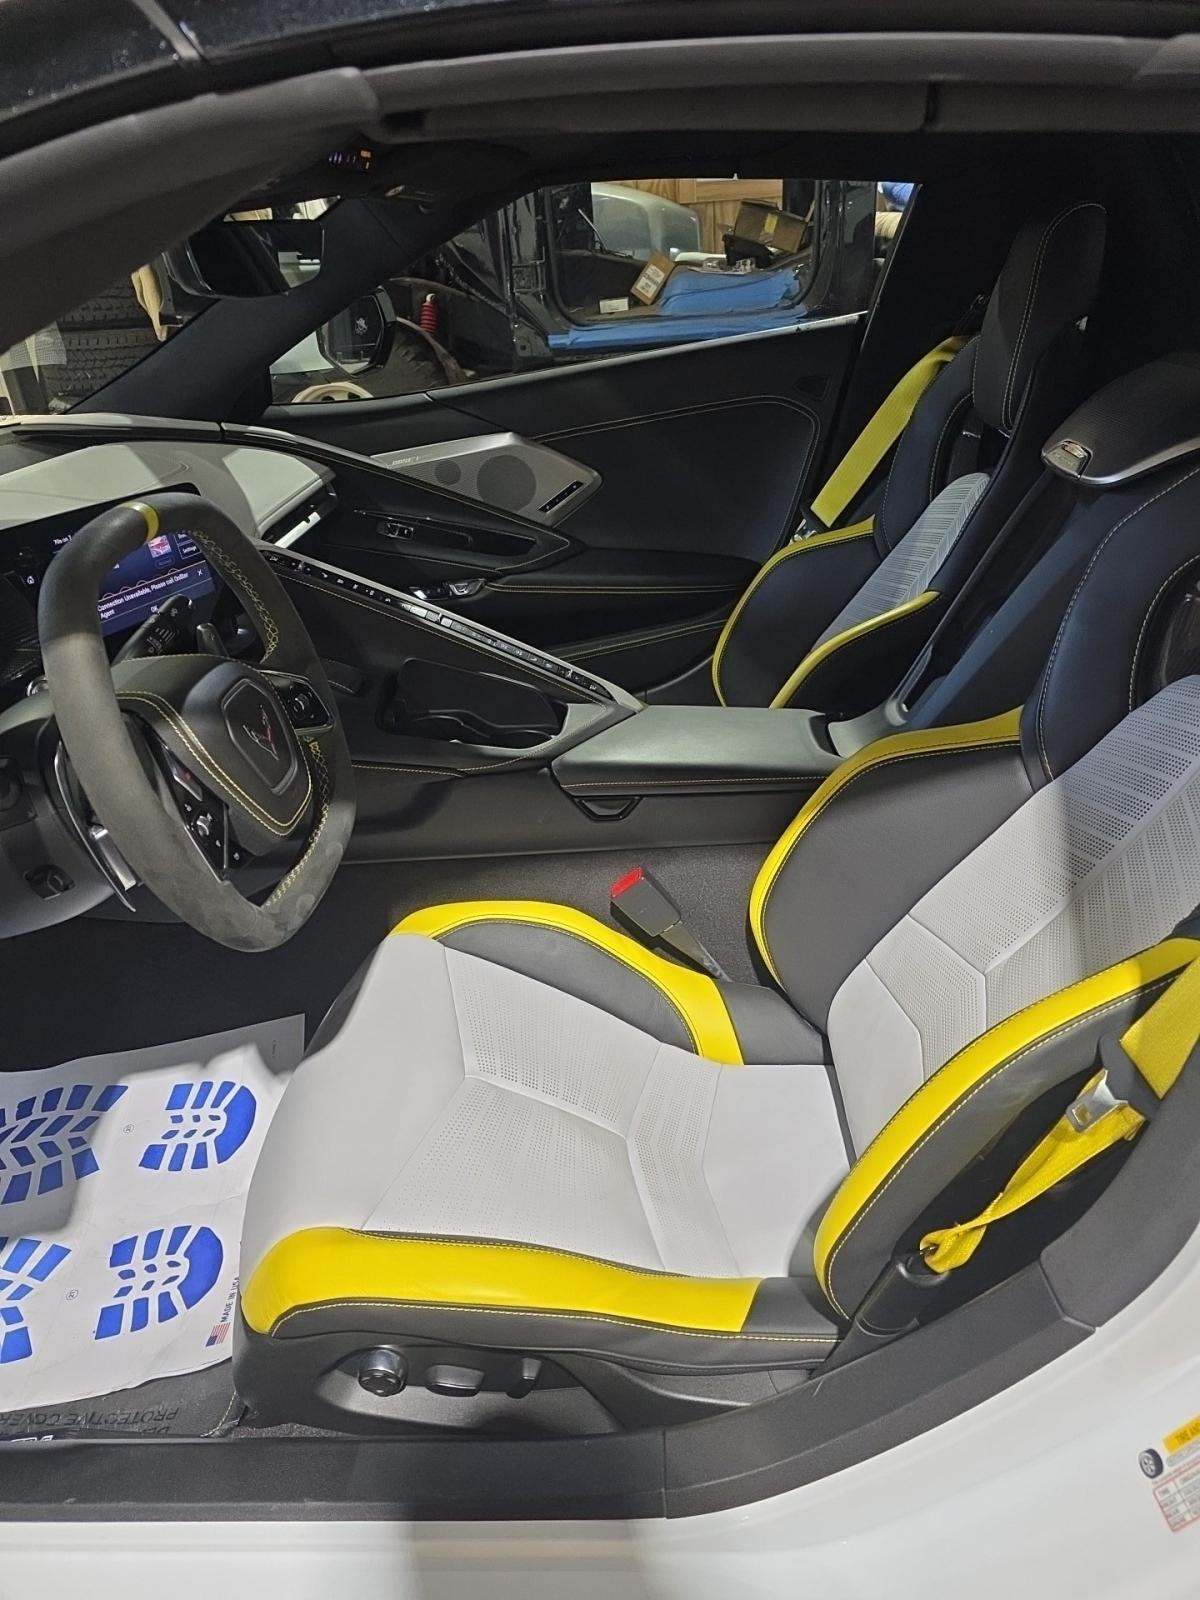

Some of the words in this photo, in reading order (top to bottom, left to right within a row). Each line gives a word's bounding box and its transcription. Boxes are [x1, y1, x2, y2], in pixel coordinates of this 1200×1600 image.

[97, 598, 125, 612] Connection
[151, 580, 166, 591] Please
[100, 609, 115, 620] Agent
[220, 1299, 233, 1323] MADE
[65, 1407, 180, 1427] PROTECTIVE
